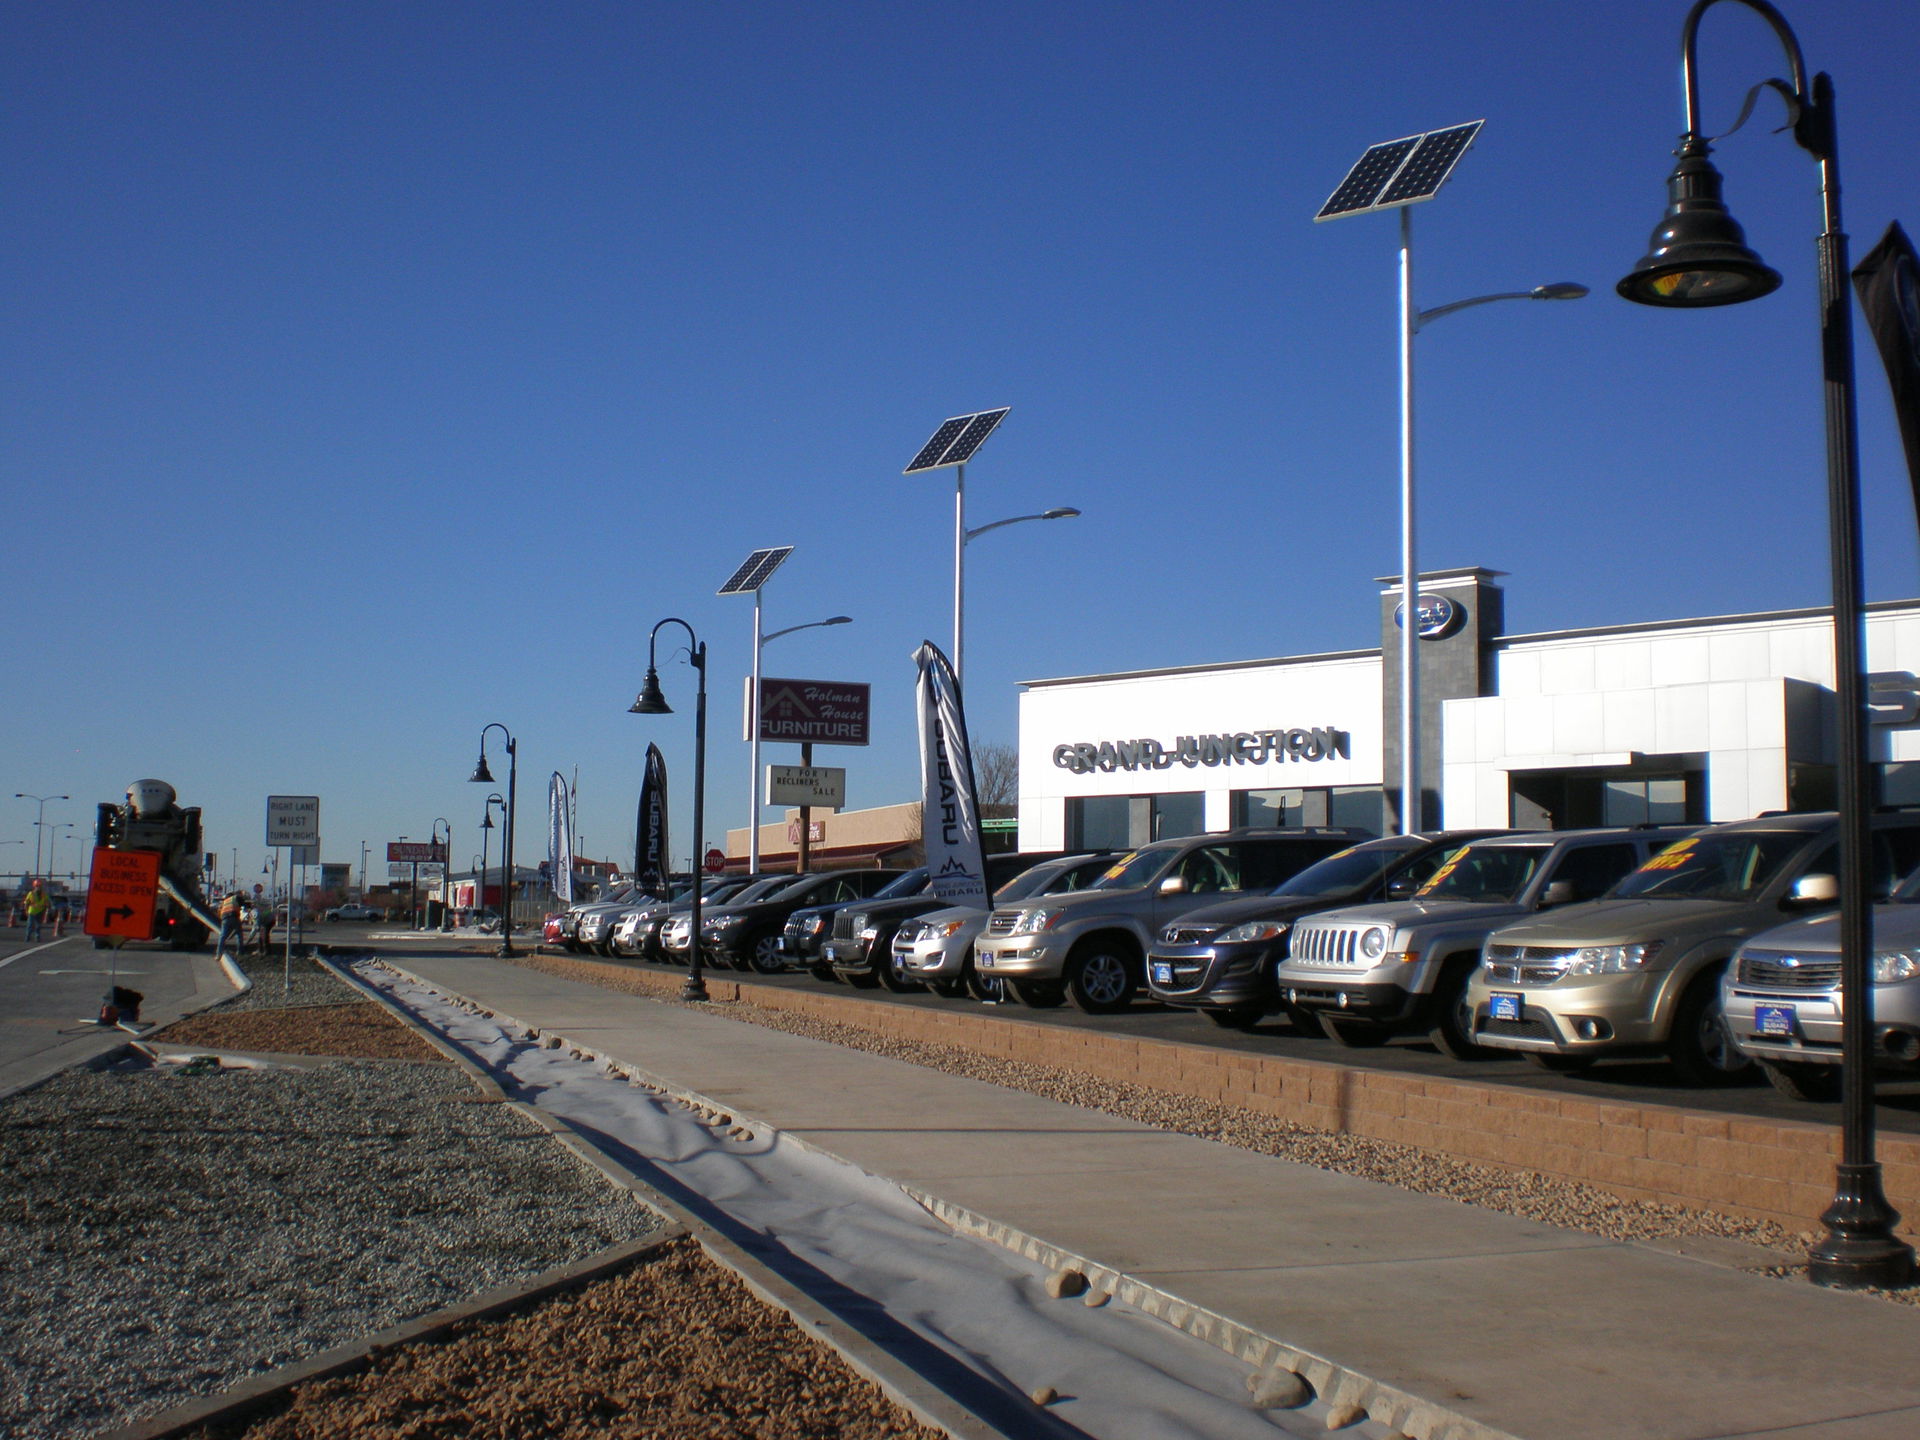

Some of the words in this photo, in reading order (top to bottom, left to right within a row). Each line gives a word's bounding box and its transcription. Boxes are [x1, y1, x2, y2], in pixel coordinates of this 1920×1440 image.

[804, 687, 860, 703] Holman
[819, 705, 864, 719] House
[760, 720, 862, 737] FURNITURE
[1053, 739, 1161, 769] GRAND
[1173, 726, 1335, 762] JUNCTION
[799, 769, 817, 777] FOR
[934, 718, 959, 846] SUBARU
[813, 788, 835, 796] SALE
[271, 802, 293, 810] RIGHT
[296, 802, 316, 811] LANE
[279, 816, 306, 826] MUST
[648, 790, 660, 862] SUBARU
[270, 832, 290, 840] TURN
[293, 832, 315, 840] RIGHT
[110, 856, 139, 867] LOCAL
[705, 857, 724, 866] STOP
[101, 869, 147, 882] BUSINESS
[95, 882, 126, 894] ACCESS
[129, 886, 153, 897] OPEN
